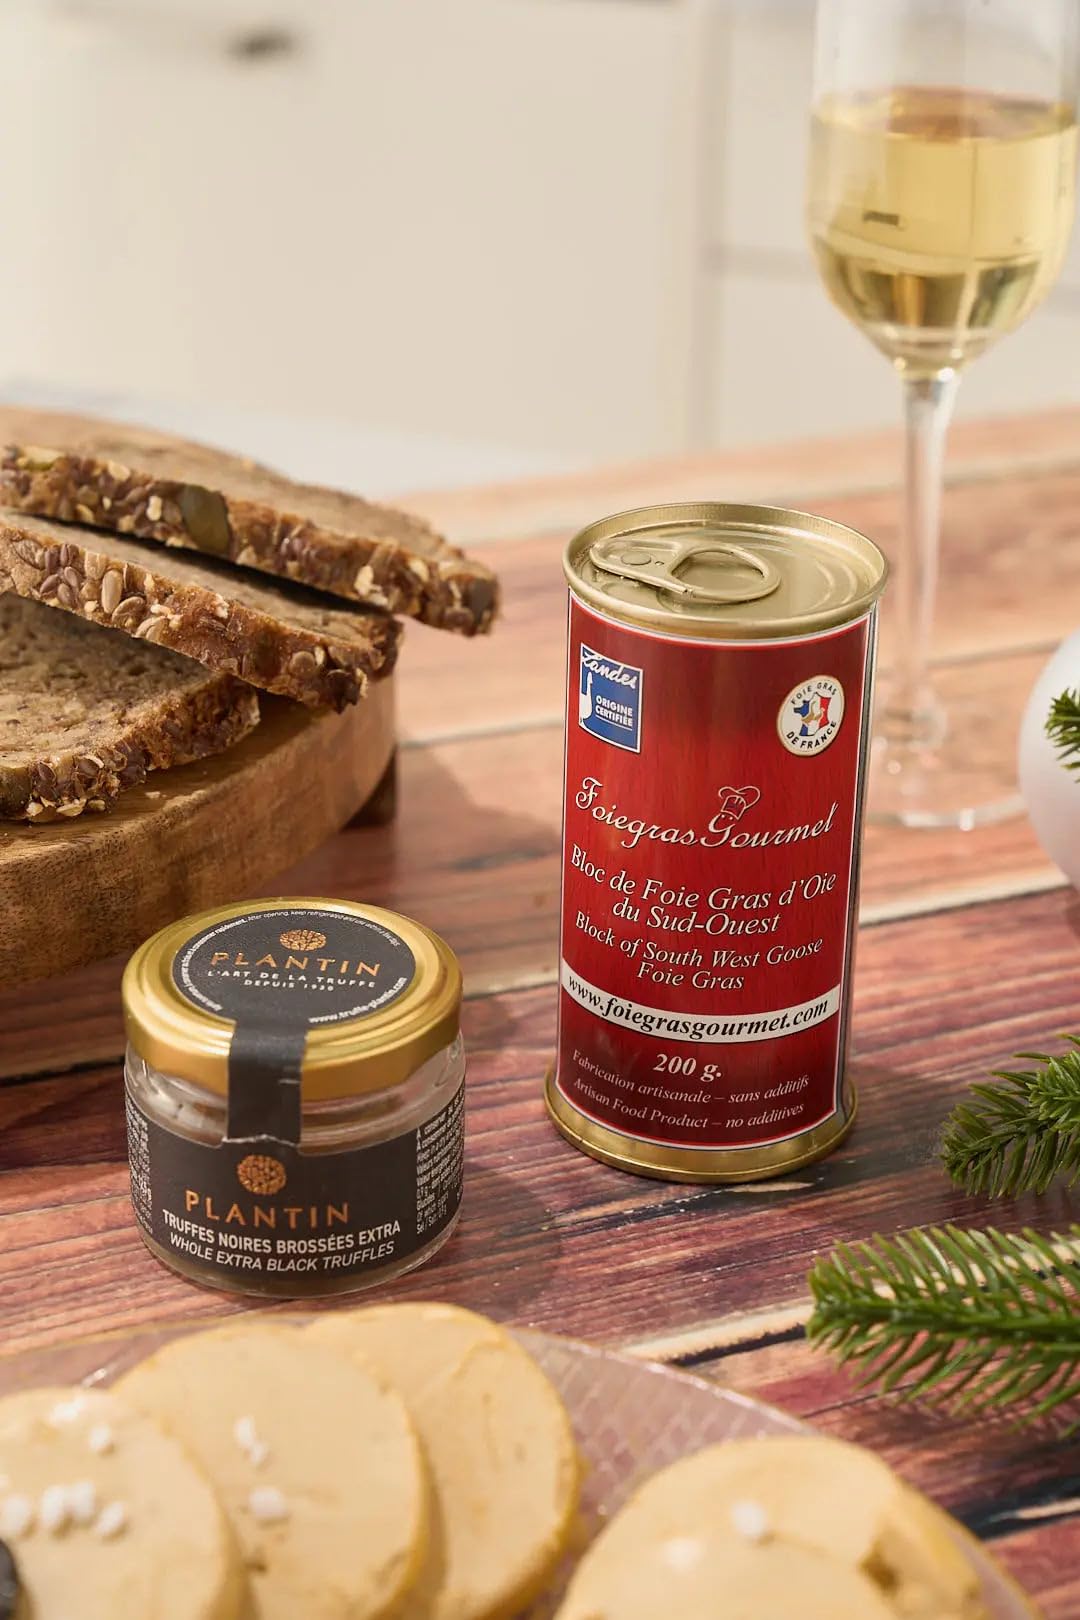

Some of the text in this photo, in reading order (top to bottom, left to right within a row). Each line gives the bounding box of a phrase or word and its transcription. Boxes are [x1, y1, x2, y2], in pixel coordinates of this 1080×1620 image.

[582, 651, 638, 689] Landes
[595, 695, 633, 717] ORIGINE
[791, 682, 837, 705] FOIE GRAS
[595, 704, 633, 727] CERTIFIÉE
[786, 721, 837, 749] DE FRANCE
[571, 843, 837, 910] Bloc de Foie Gras d'Oie
[612, 897, 781, 936] du Sud-Ouest
[575, 910, 823, 968] Block of South West Goose
[207, 970, 376, 989] L'ART DE LA TRUFFE
[210, 952, 381, 977] PLANTIN
[637, 961, 745, 989] Foie Gras
[243, 979, 296, 989] DEPUIS
[568, 975, 829, 1041] www.foiegrasgourmet.com
[572, 1049, 635, 1091] Fabrication
[638, 1083, 712, 1104] artisanale
[728, 1091, 761, 1104] sans
[763, 1074, 809, 1100] additifs
[653, 1053, 722, 1083] 200 g.
[573, 1078, 610, 1106] Artisan
[612, 1097, 648, 1120] Food
[650, 1108, 709, 1129] Product
[725, 1118, 744, 1129] no
[747, 1104, 805, 1127] additives
[185, 1189, 349, 1230] PLANTIN
[162, 1209, 401, 1254] TRUFFES NOIRES BROSSÉES EXTRA
[170, 1231, 395, 1272] WHOLE EXTRA BLACK TRUFFLES
